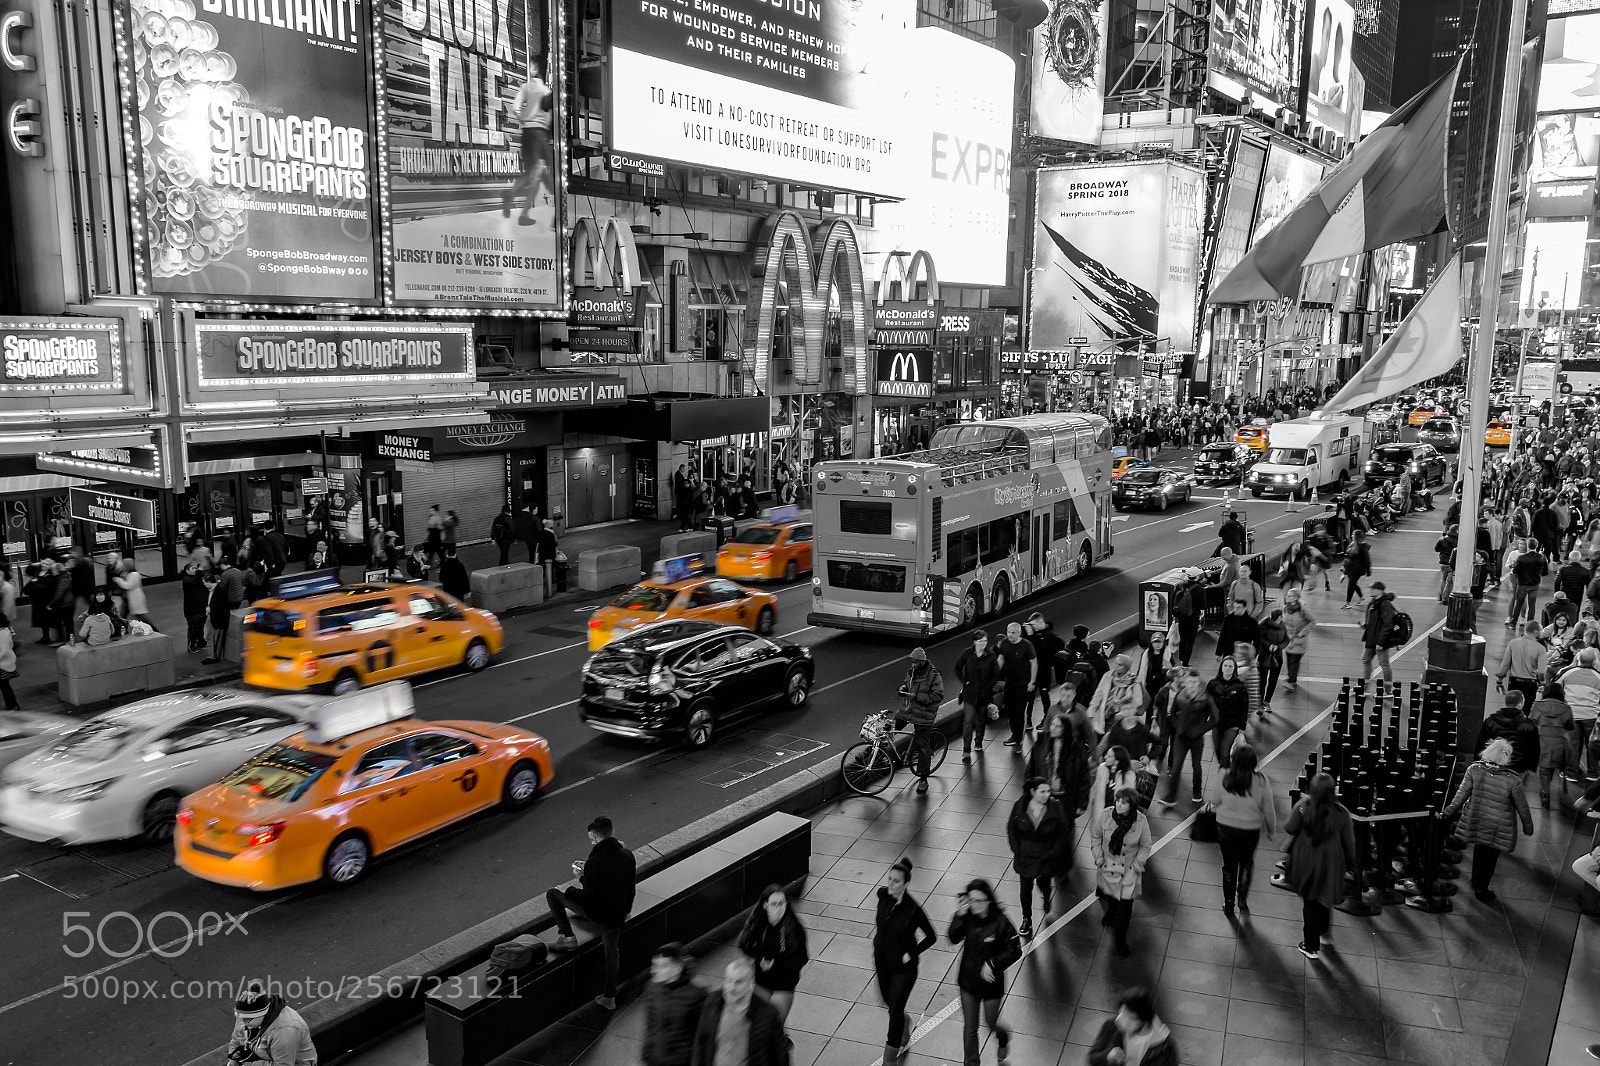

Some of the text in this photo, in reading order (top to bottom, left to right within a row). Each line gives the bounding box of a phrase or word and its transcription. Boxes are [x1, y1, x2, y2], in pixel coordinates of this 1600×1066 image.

[307, 38, 316, 46] THE
[641, 0, 840, 71] FOR WOUNDED SERVICE MEMBERS
[761, 21, 784, 36] AND
[788, 29, 824, 49] RENEW
[686, 35, 807, 79] AND THEIR FAMILIES
[422, 38, 506, 146] TALE
[650, 86, 893, 155] TO ATTEND A NO-COST RETREAT OR SUPPORT LSF
[683, 121, 872, 173] VISIT LONESURVIVORFOUNDATION.ORG
[400, 147, 460, 174] BROADWAY'S
[461, 149, 478, 173] NEW
[479, 150, 492, 173] HIT
[213, 154, 367, 200] SQUAREPANTS
[1070, 180, 1129, 191] BROADWAY
[1068, 189, 1129, 200] SPRING 2018
[233, 200, 277, 212] BROADWAY
[278, 202, 318, 217] MUSICAL
[318, 207, 333, 217] FOR
[333, 208, 368, 220] EVERYONE
[1060, 209, 1136, 219] HarryPotterThePlay.com
[451, 235, 504, 250] COMBINATION
[505, 239, 515, 252] OF
[246, 247, 368, 263] SpongeBobBroadway.com
[394, 248, 434, 264] JERSEY
[436, 252, 463, 266] BOYS
[465, 253, 472, 265] &
[473, 253, 500, 267] WEST
[502, 256, 523, 270] SIDE
[258, 262, 346, 277] @SpongeBobBway
[570, 299, 633, 312] McDonald's
[577, 313, 621, 322] Restaurant
[876, 309, 935, 319] McDonald's
[937, 316, 971, 331] PRESS
[4, 335, 97, 362] SPONGEBOB
[570, 337, 590, 345] OPEN
[602, 338, 628, 346] HOURS
[238, 336, 442, 371] SPONGEBOB SQUAREPANTS
[1049, 352, 1116, 365] LUGAGE
[5, 359, 99, 380] SQUAREPANTS
[490, 385, 624, 405] ANGE MONEY ATM
[447, 422, 526, 436] MONEY EXCHANGE
[384, 434, 419, 448] MONEY
[378, 444, 431, 460] EXCHANGE
